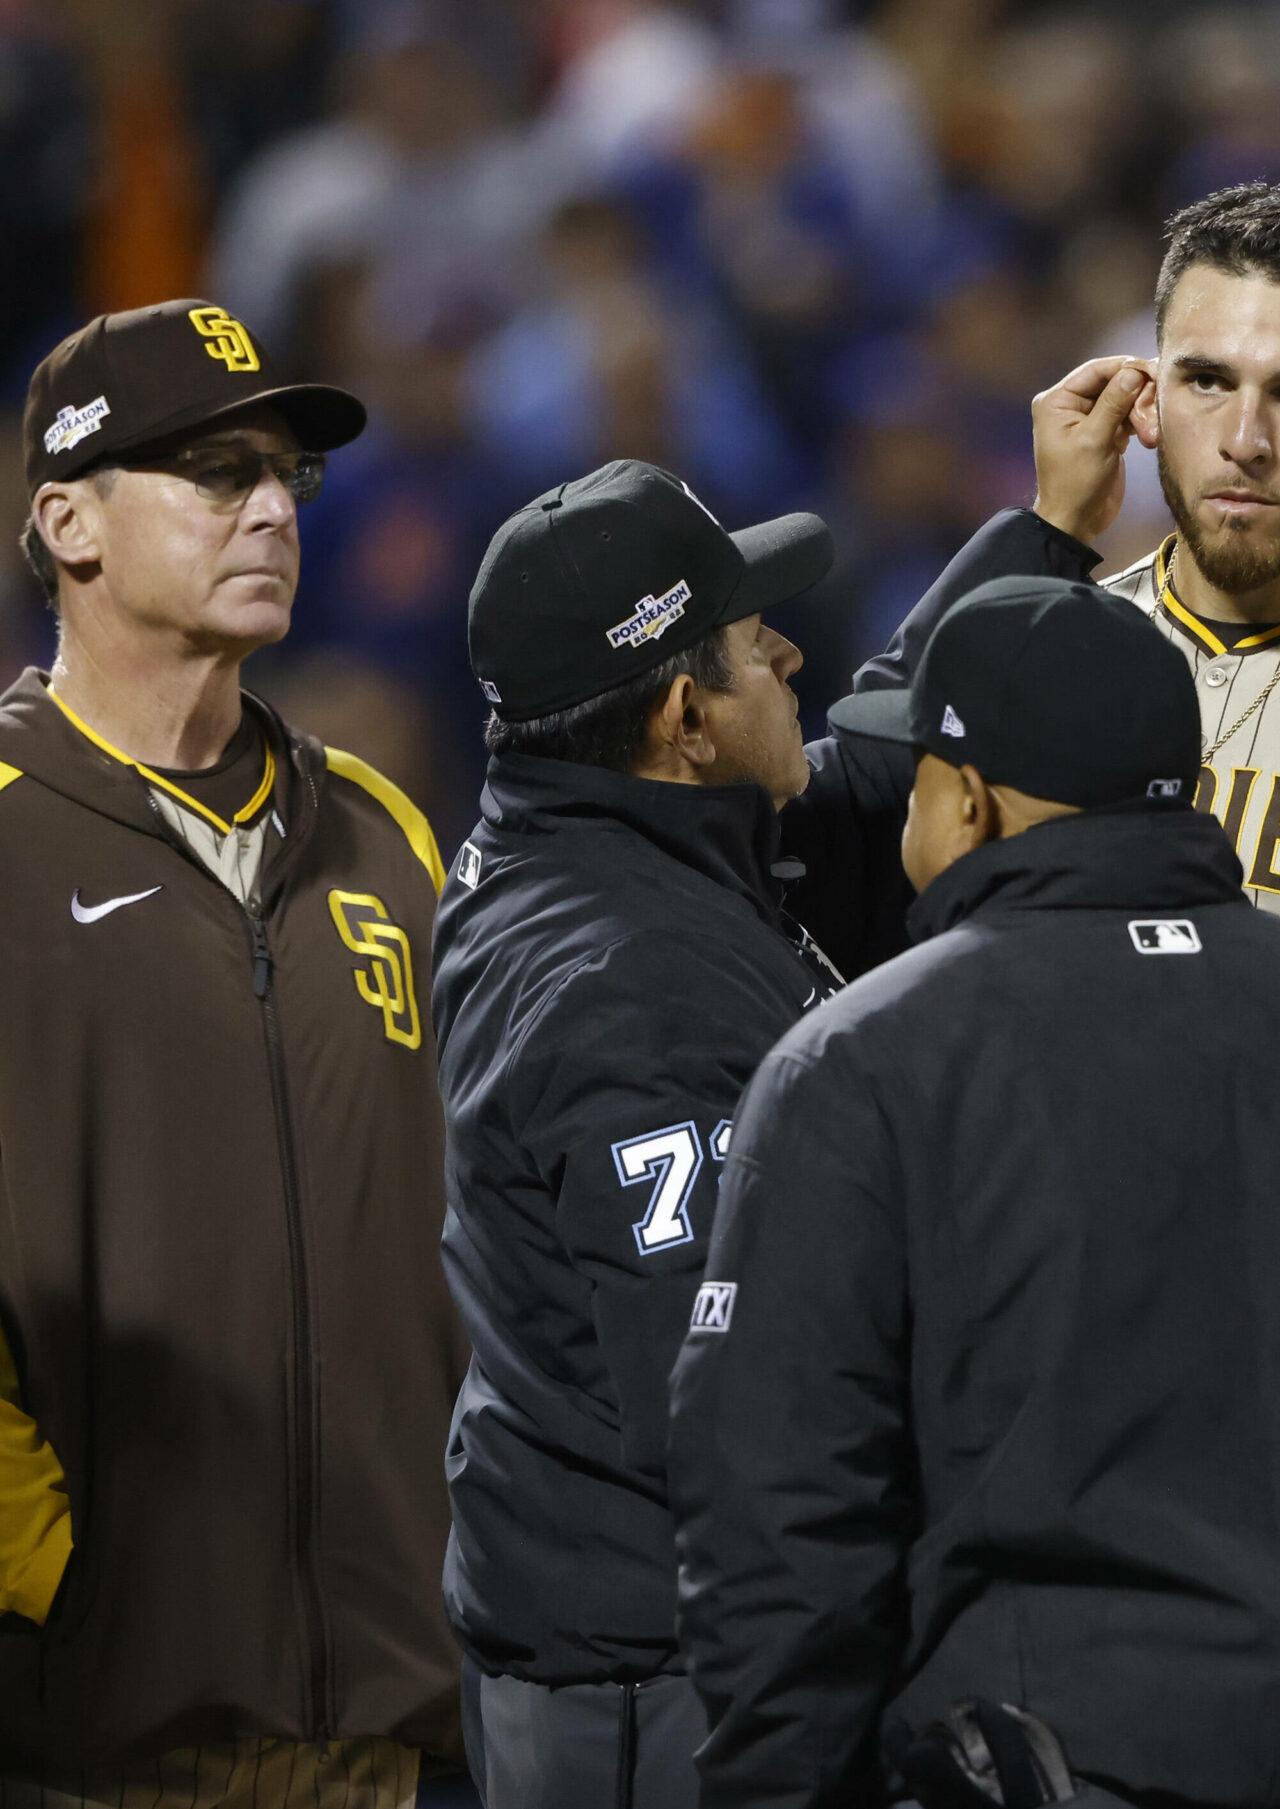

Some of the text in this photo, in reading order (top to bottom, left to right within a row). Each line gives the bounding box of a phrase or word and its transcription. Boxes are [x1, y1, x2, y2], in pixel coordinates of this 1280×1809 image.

[46, 402, 105, 444] OSTSEASON
[611, 585, 688, 644] POSTSEASON
[610, 1119, 732, 1256] 7
